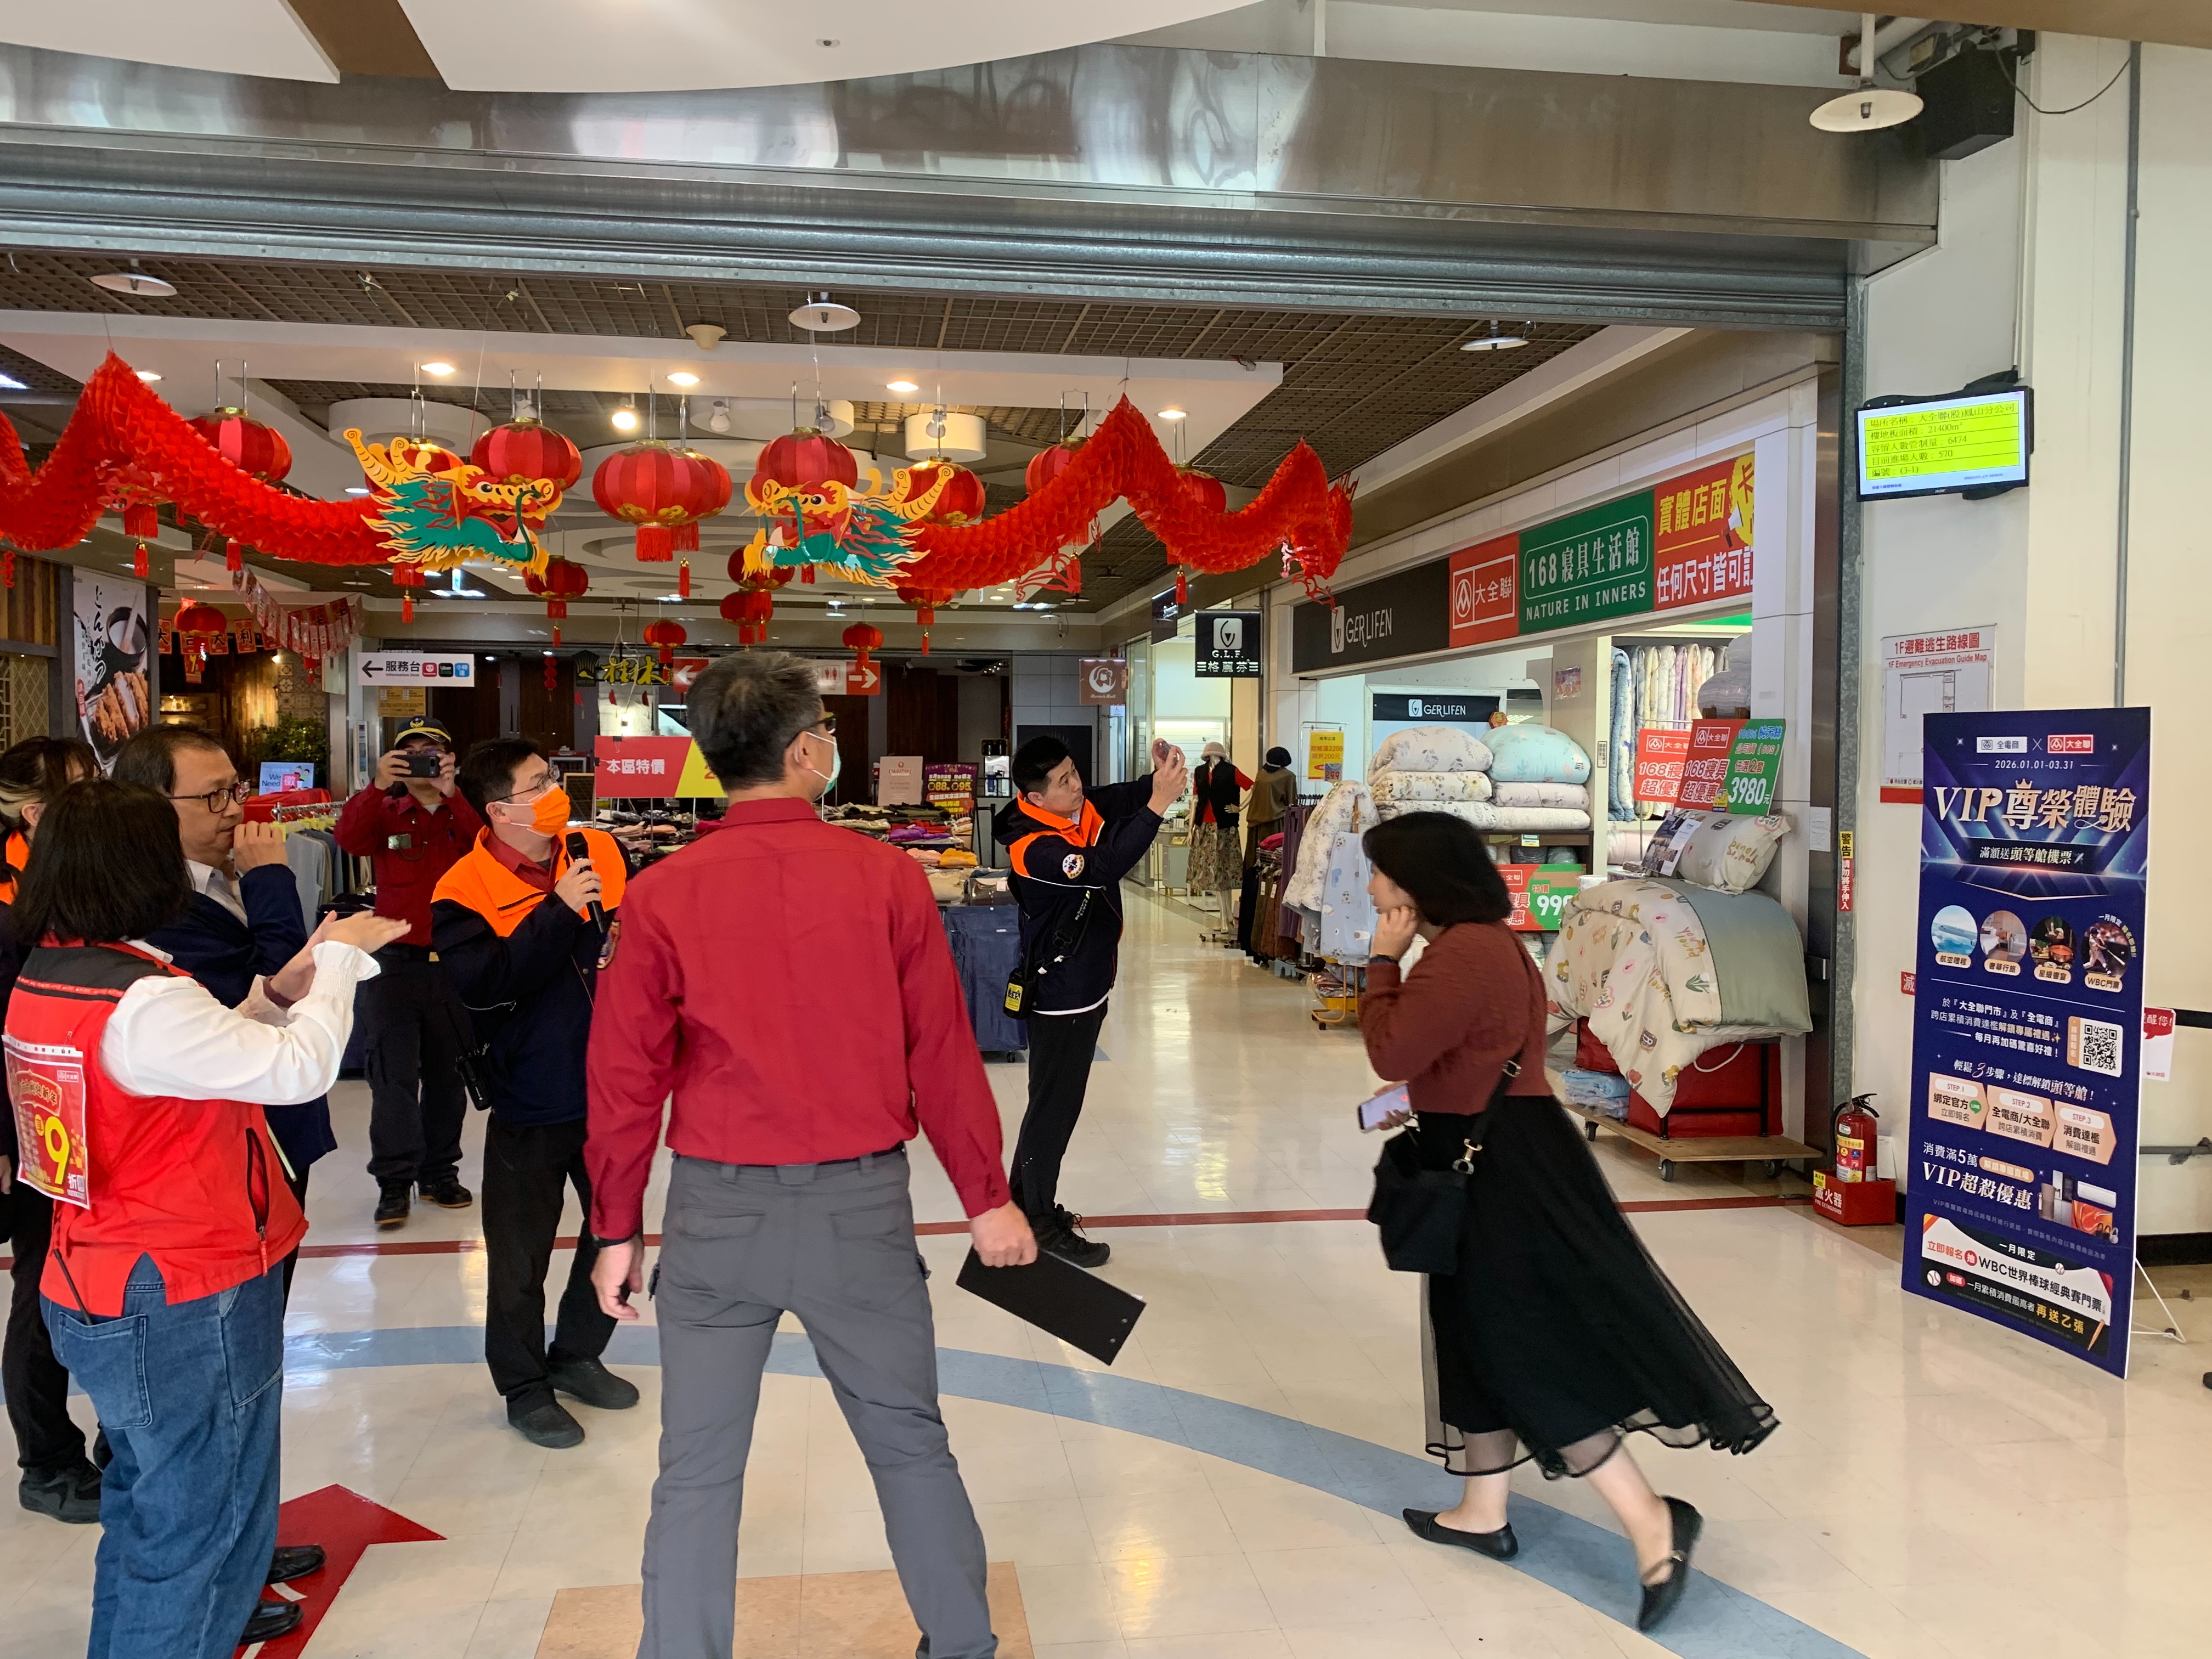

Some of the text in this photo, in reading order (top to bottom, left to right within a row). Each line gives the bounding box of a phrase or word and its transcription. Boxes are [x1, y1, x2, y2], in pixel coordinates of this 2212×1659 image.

[1658, 478, 1727, 537] 實體店面
[1475, 574, 1513, 605] 大全聯
[1526, 581, 1646, 621] NATURE IN INNERS
[1346, 608, 1392, 647] GERLIFEN
[1895, 633, 1980, 654] 1F避難逃生路線圖
[386, 661, 420, 672] 服務台
[1208, 661, 1248, 673] 格麗芬
[1895, 659, 1923, 668] Emergency
[1925, 657, 1955, 665] Evacuation
[1424, 704, 1466, 717] GERLIFEN
[1997, 740, 2019, 750] 全電商
[2066, 740, 2091, 749] 大全聯
[606, 759, 665, 774] 本區特價
[1995, 760, 2074, 770] 2026.01.01-03.31
[1640, 780, 1680, 797] 超優
[1728, 776, 1767, 805] 3980
[1763, 794, 1770, 804] 元
[1933, 785, 2137, 832] VIP尊榮體驗
[1841, 833, 1851, 857] 警告
[1979, 847, 2073, 865] 滿額送頭等艙機票
[1532, 884, 1550, 894] 特價
[1841, 860, 1850, 910] 請勿將手伸入
[1989, 961, 2016, 973] 奢華行旅
[2087, 977, 2119, 989] WBC門票
[1947, 1084, 1965, 1092] STEP.1
[1933, 1093, 1968, 1110] 綁定官方
[2012, 1098, 2030, 1108] STEP.2
[1941, 1108, 1970, 1122] 立即報名
[1992, 1107, 2050, 1130] 全電商/大全聯
[2073, 1114, 2091, 1124] STEP.3
[1998, 1121, 2042, 1141] 跨店累積消費
[45, 1116, 70, 1184] 9
[1923, 1142, 1978, 1167] 消費滿5萬
[1922, 1161, 2033, 1210] VIP超殺優惠
[1999, 1243, 2036, 1261] 一月限定
[1927, 1240, 1963, 1260] 立即報名
[1979, 1256, 2102, 1313] WBC世界棒球經典賽門票
[1949, 1274, 1963, 1285] 加碼
[1967, 1282, 2035, 1313] 一月累積消費最高者
[2036, 1304, 2084, 1334] 再送乙張
